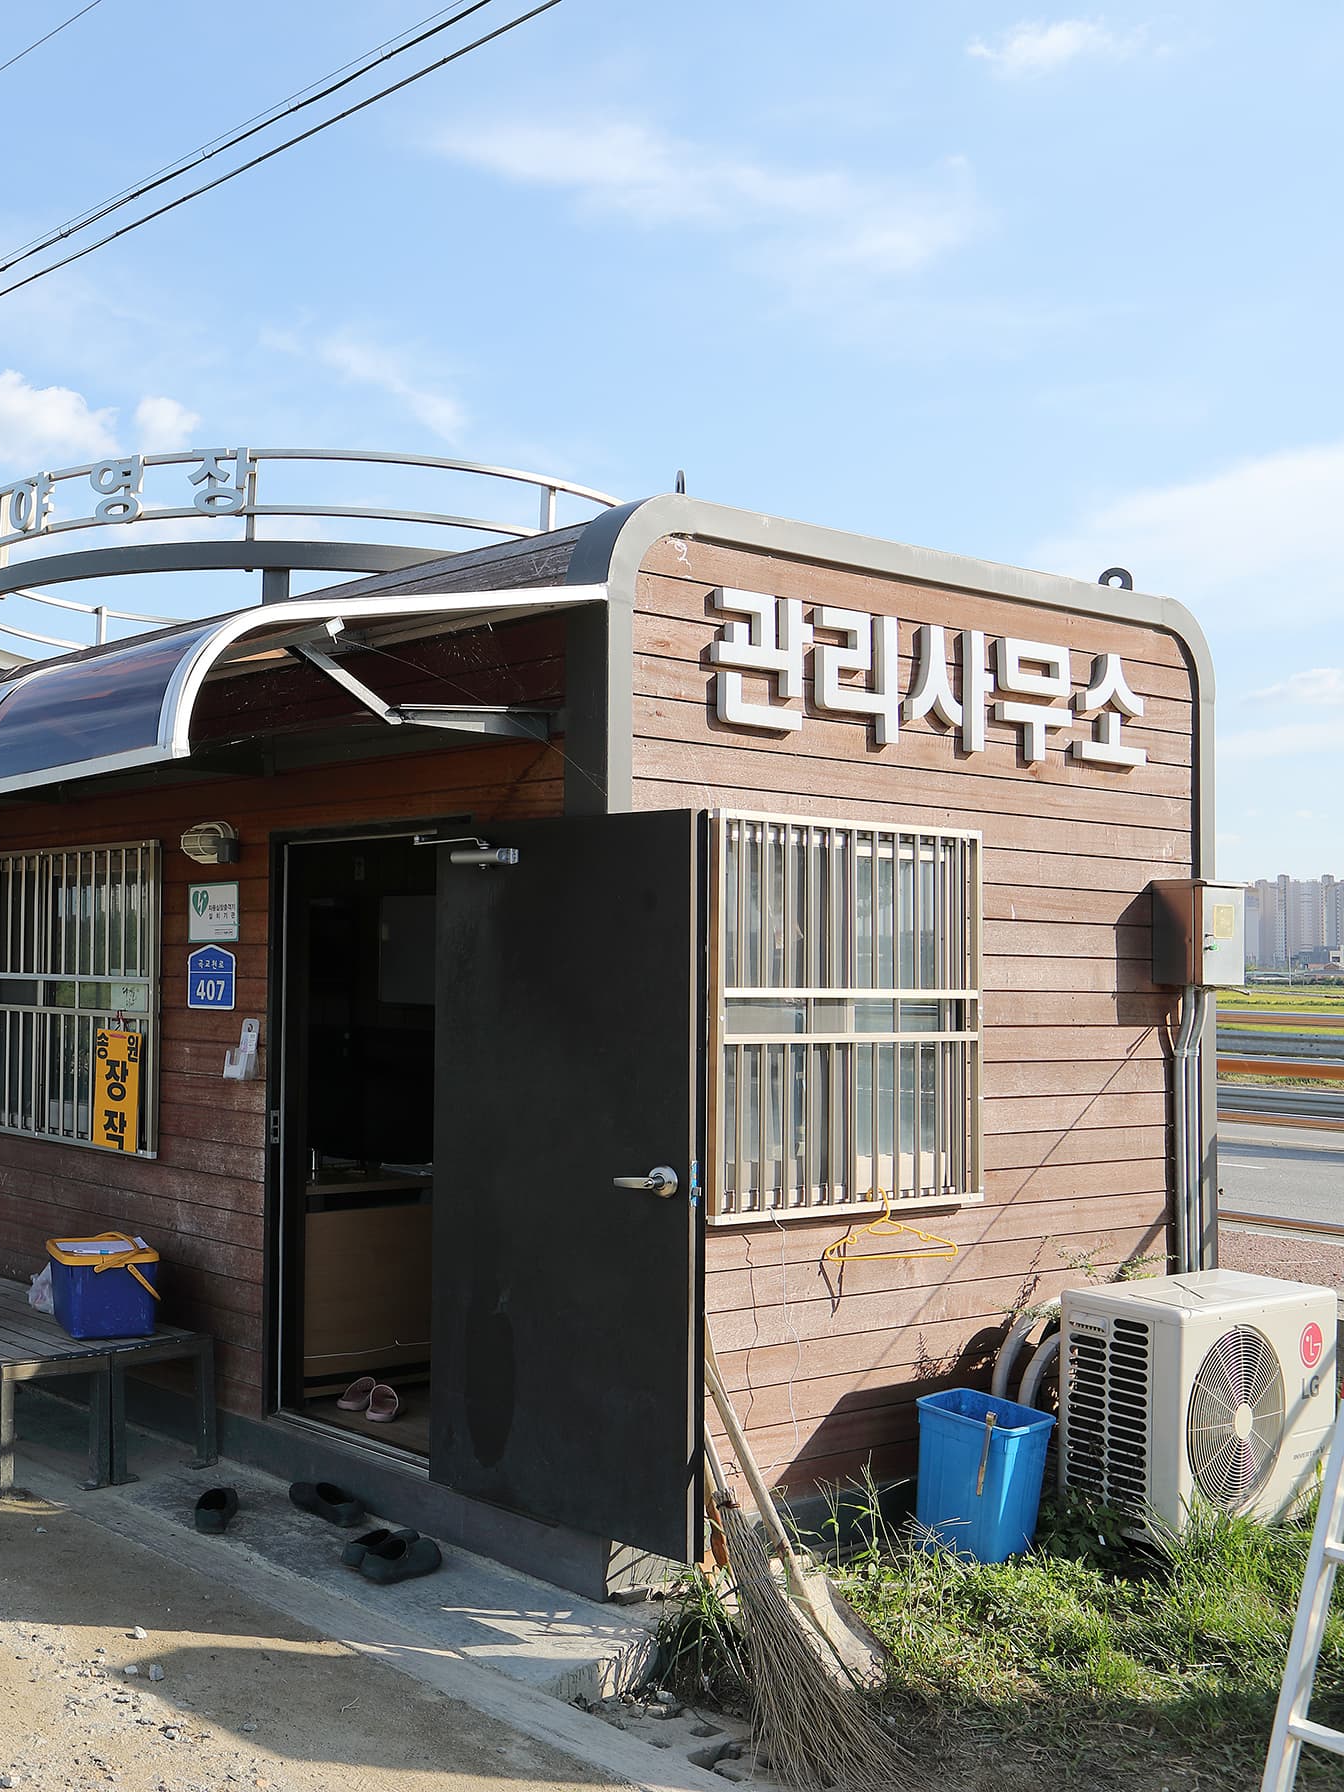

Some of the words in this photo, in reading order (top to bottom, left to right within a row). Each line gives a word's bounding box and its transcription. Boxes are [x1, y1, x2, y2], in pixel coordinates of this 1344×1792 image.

[710, 587, 1147, 767] 관리사무소
[196, 979, 225, 1001] 407
[1301, 1375, 1320, 1400] LG
